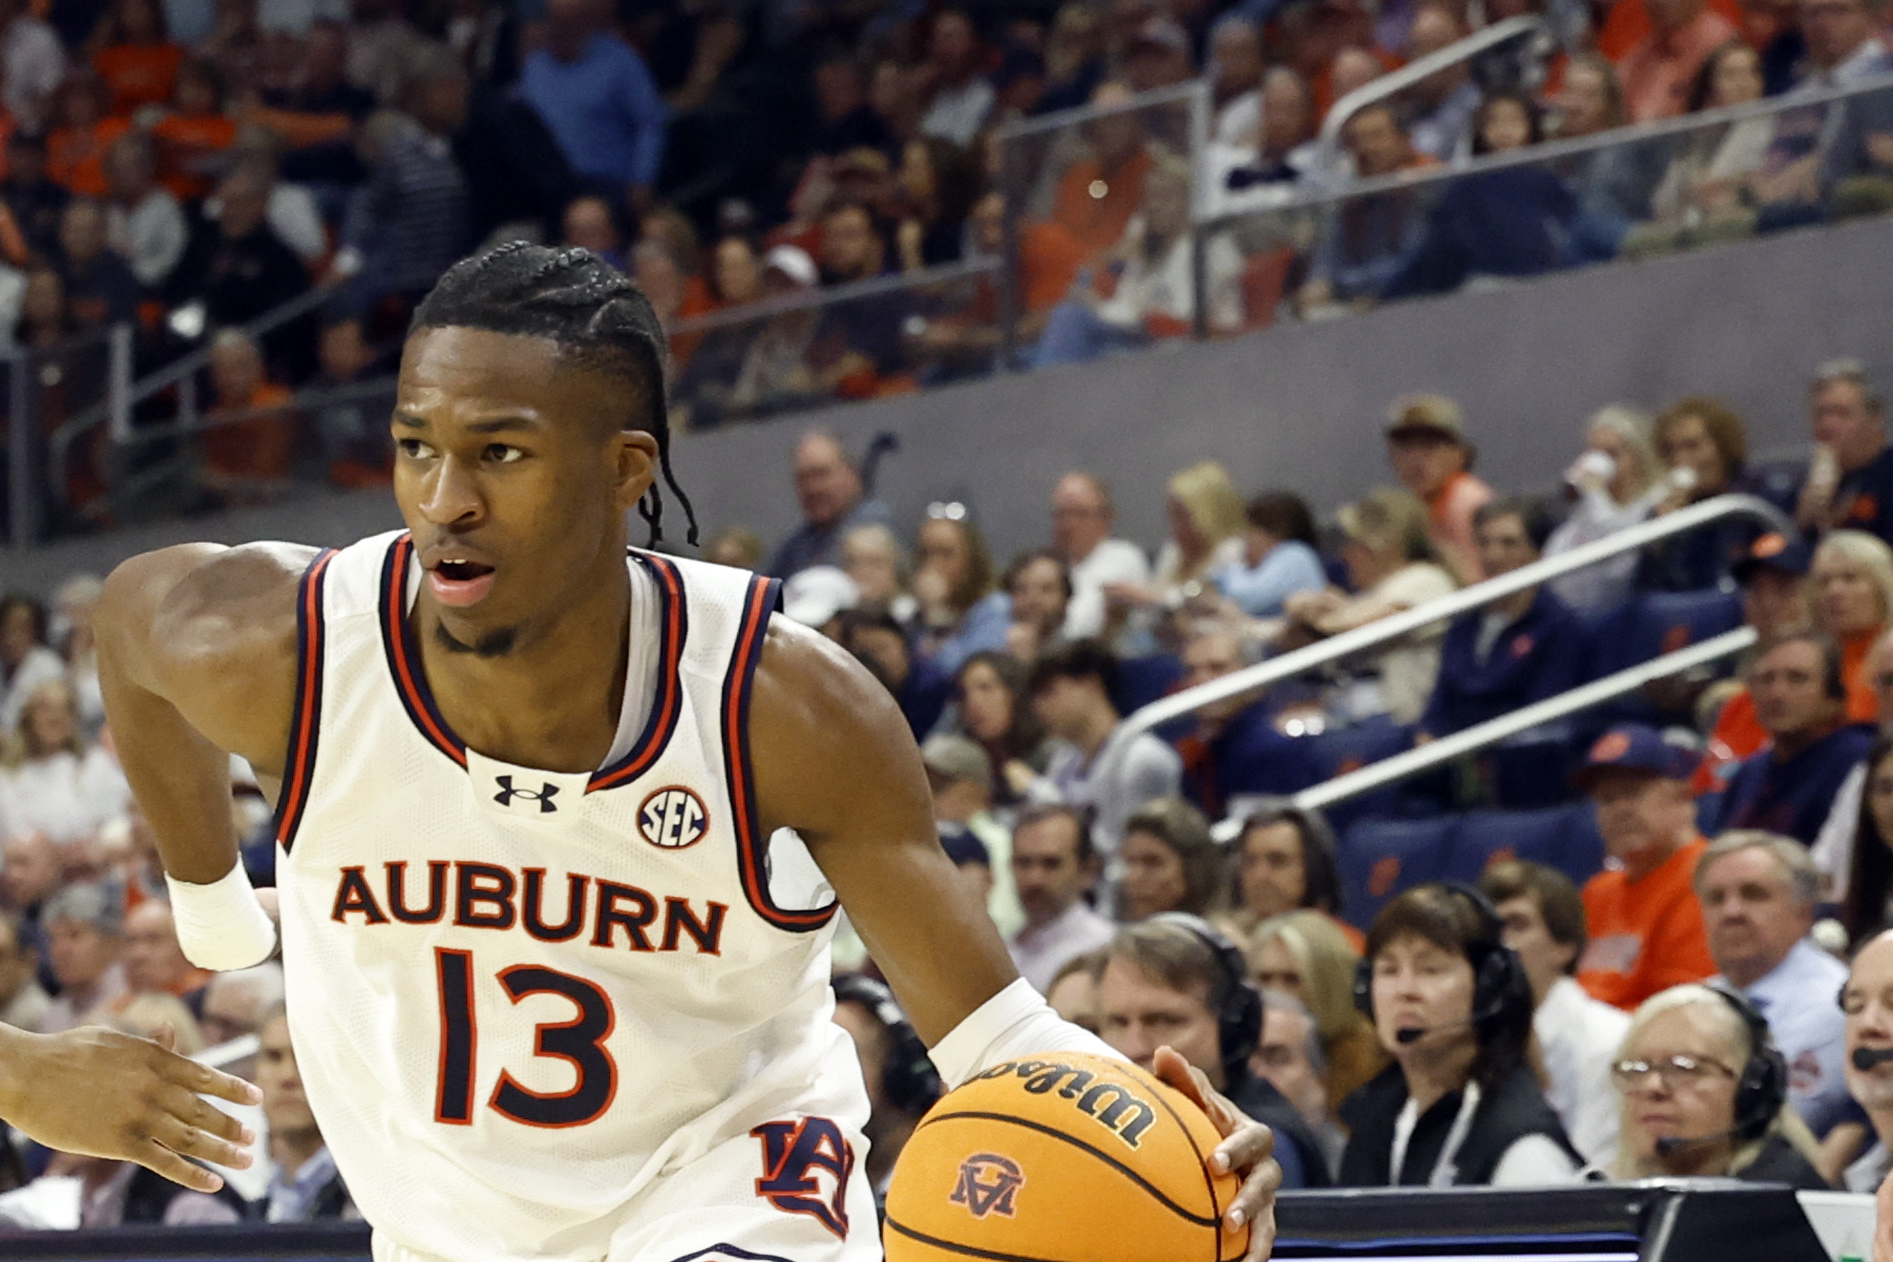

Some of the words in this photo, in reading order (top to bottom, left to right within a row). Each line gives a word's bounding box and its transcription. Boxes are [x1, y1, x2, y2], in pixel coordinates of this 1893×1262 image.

[640, 789, 705, 847] SEC
[331, 860, 728, 957] AUBURN
[434, 946, 619, 1130] 13
[964, 1061, 1158, 1151] Wilso
